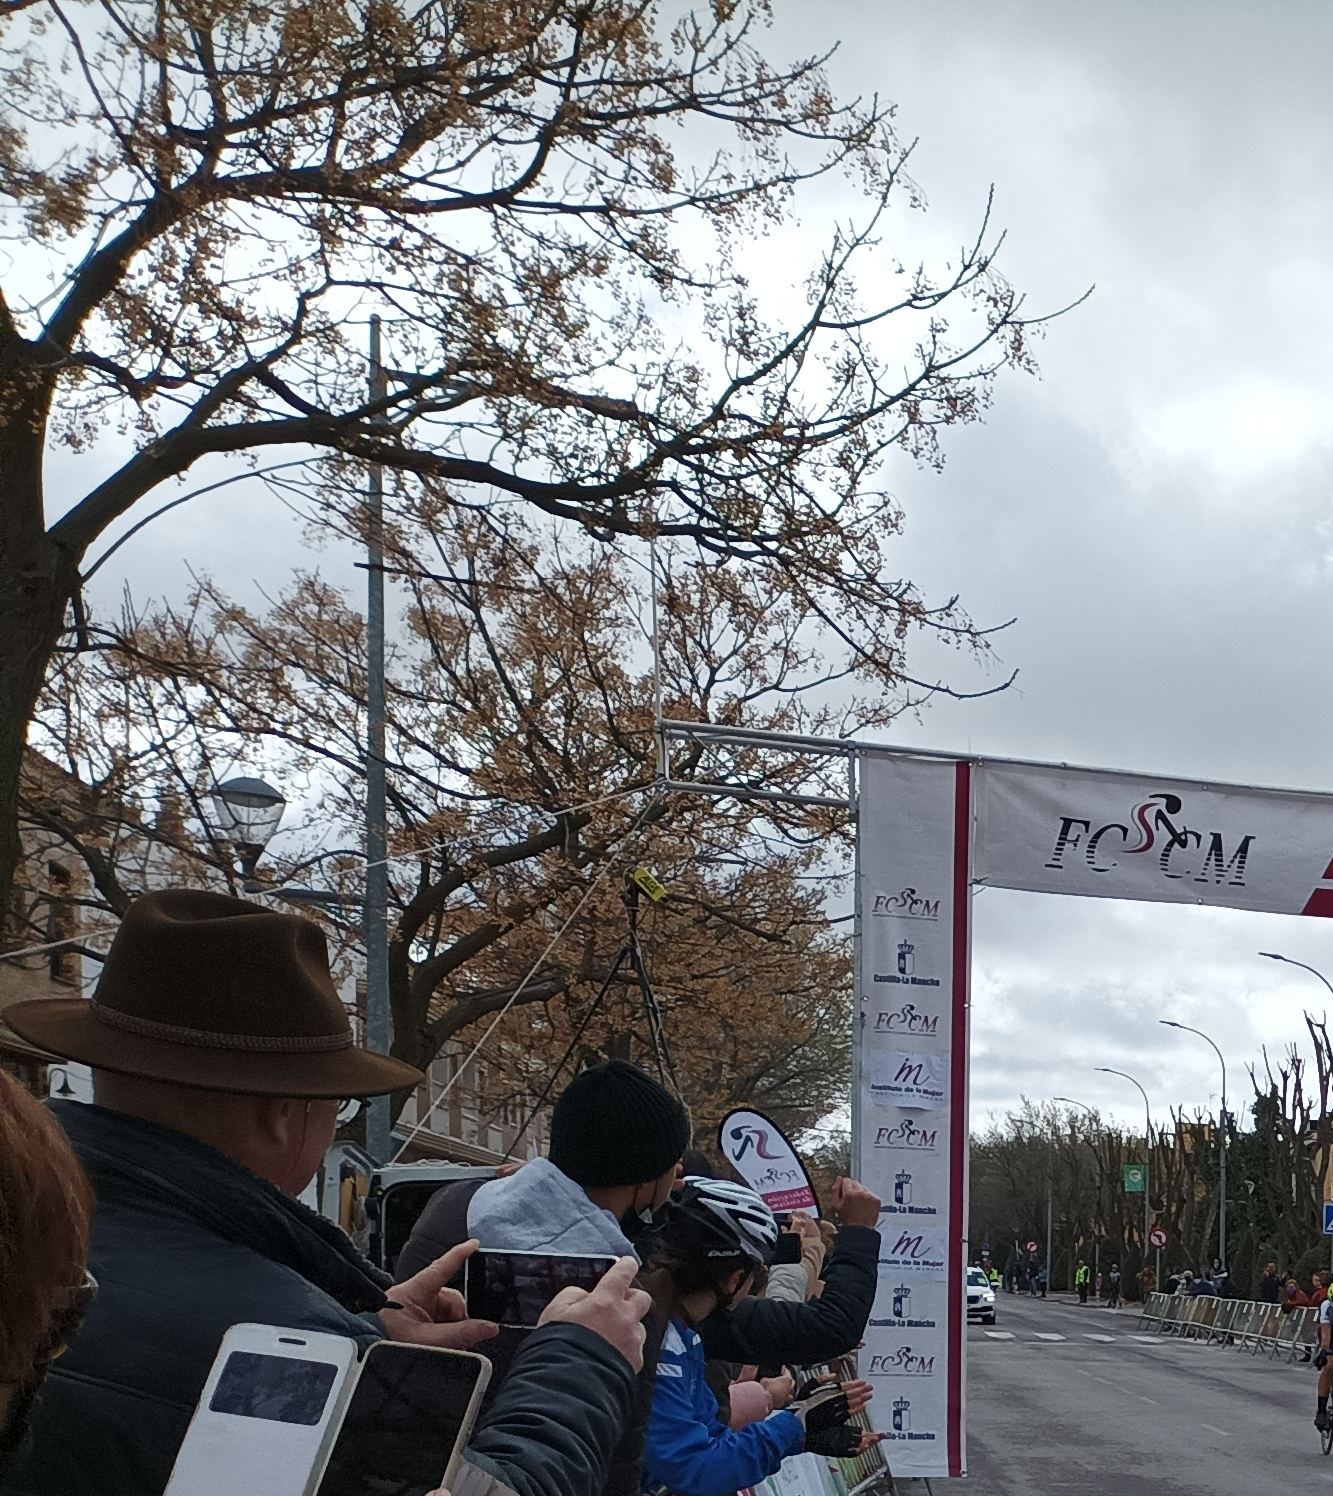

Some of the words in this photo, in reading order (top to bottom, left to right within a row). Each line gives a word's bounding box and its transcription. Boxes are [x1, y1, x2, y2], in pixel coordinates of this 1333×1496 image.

[910, 976, 940, 987] Mancha
[903, 1086, 914, 1094] de
[922, 1089, 944, 1098] Mujer
[922, 1260, 944, 1268] Mujer
